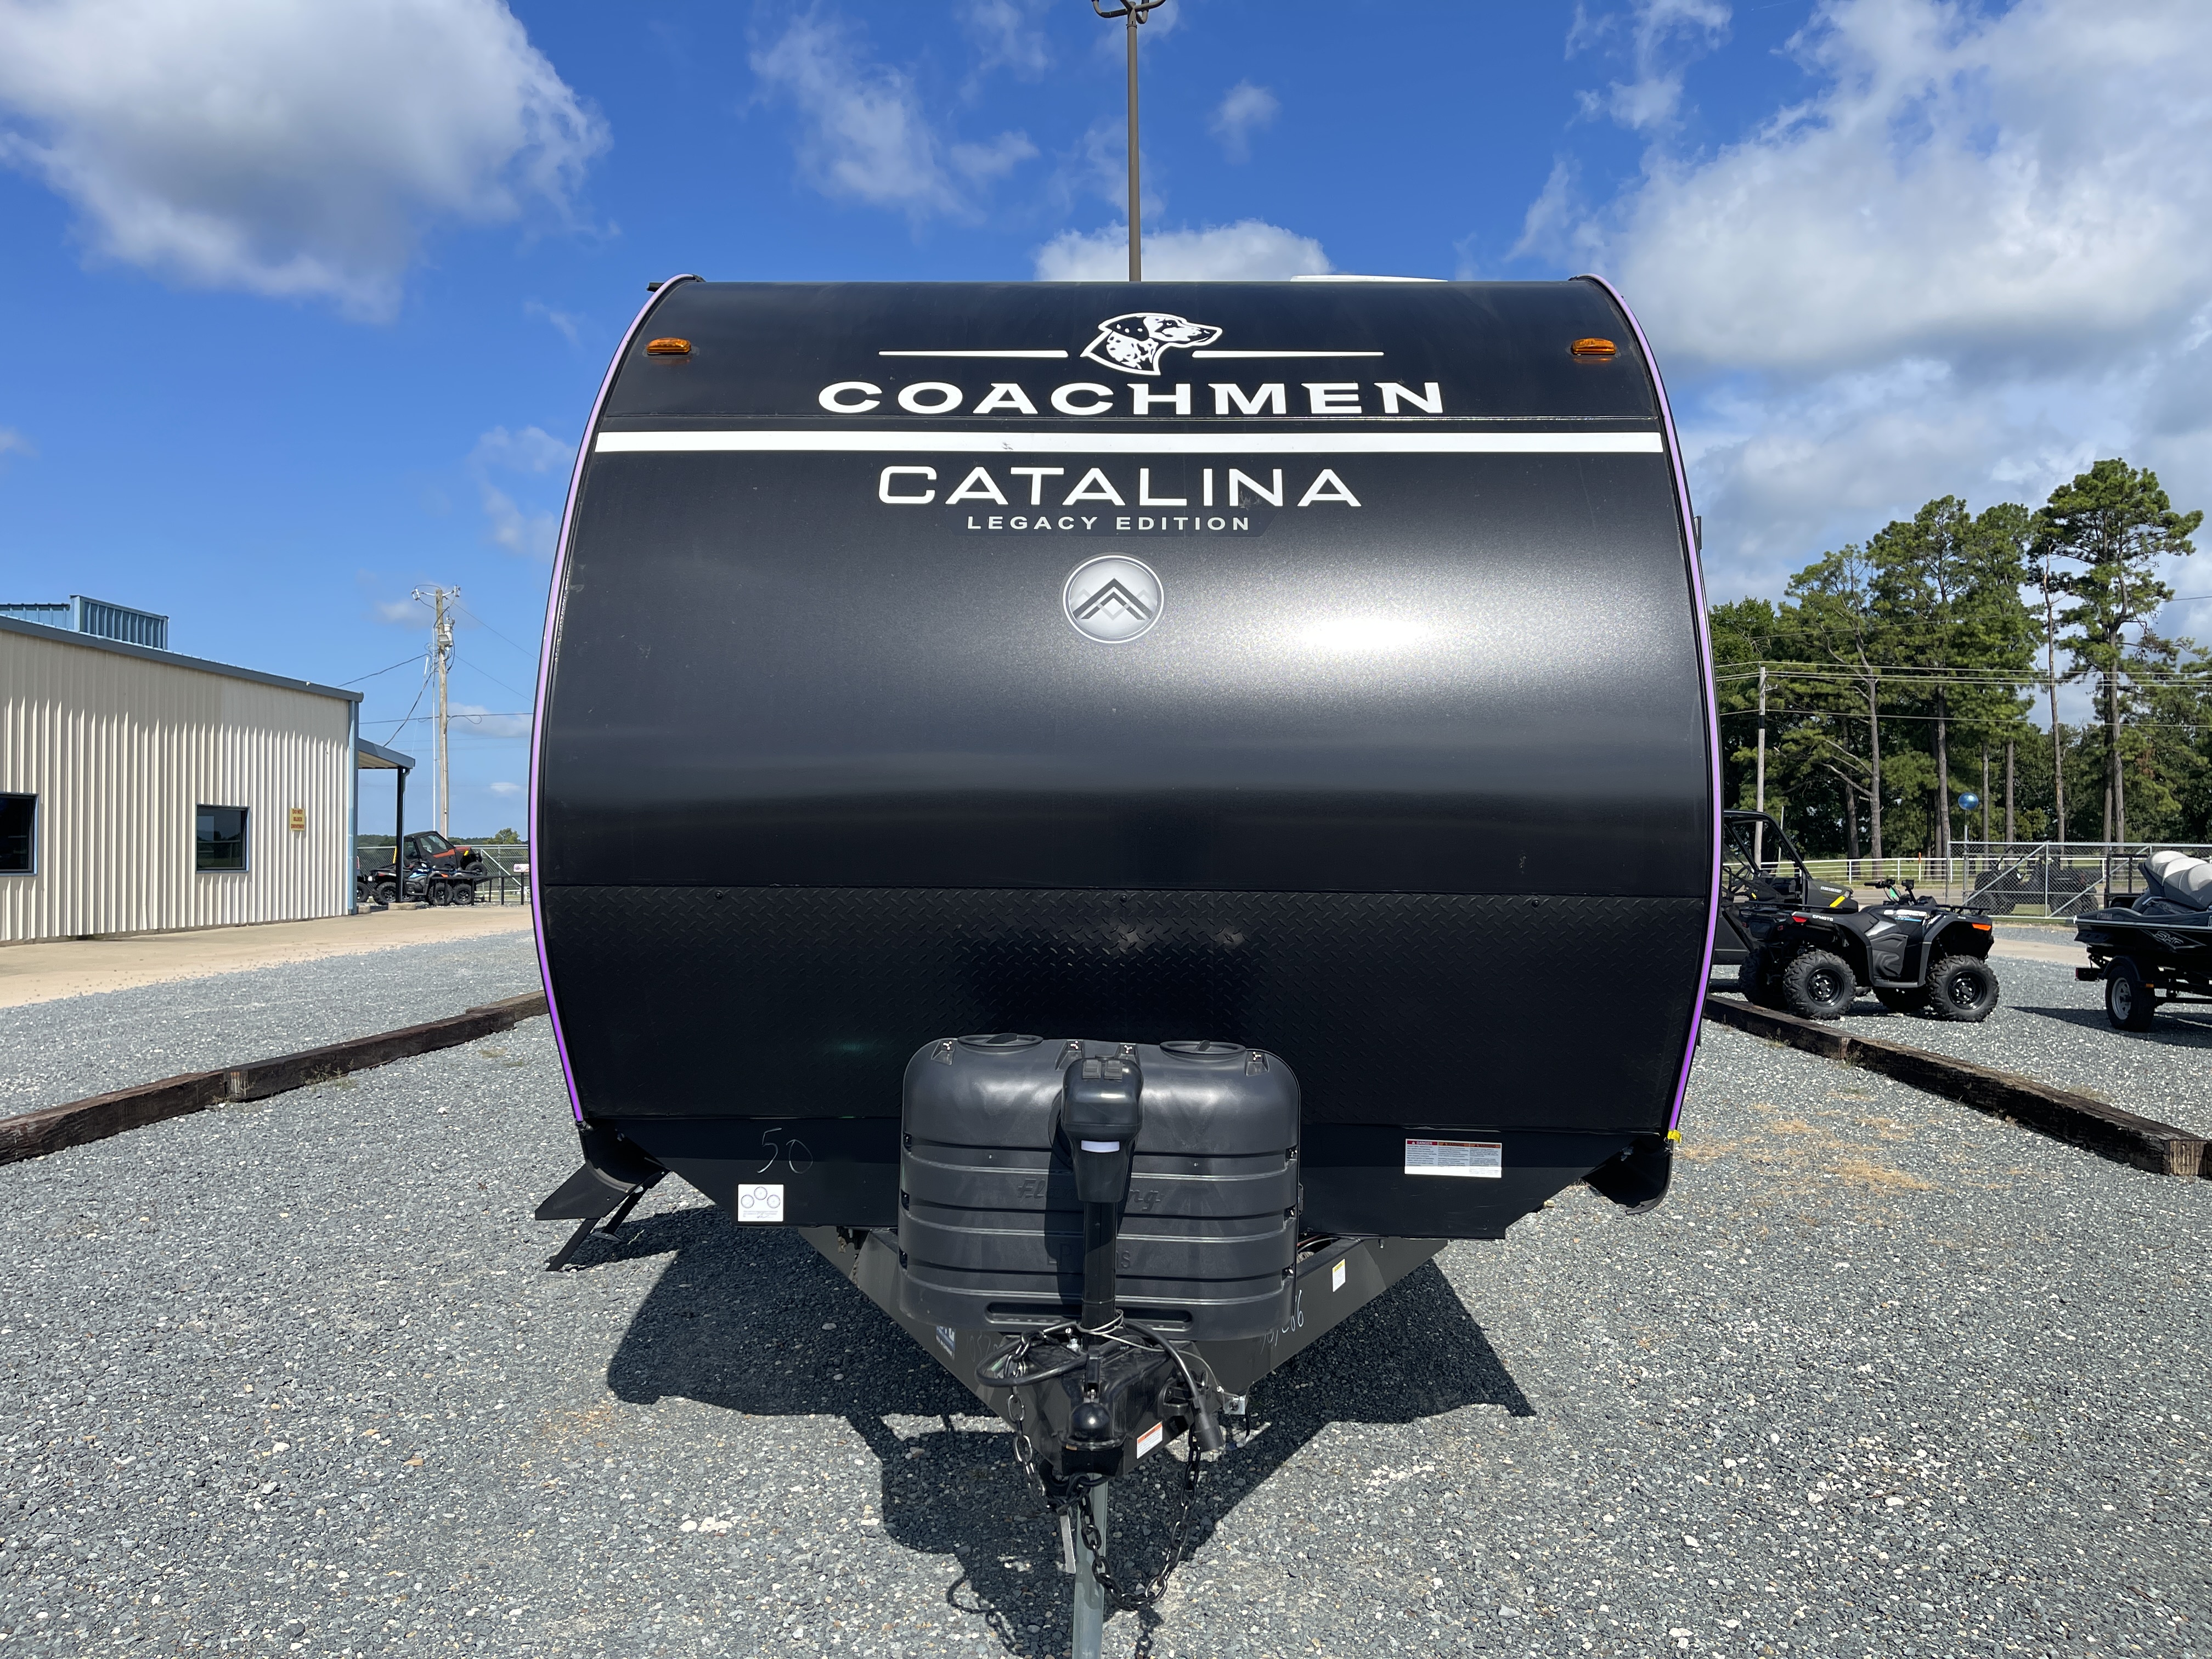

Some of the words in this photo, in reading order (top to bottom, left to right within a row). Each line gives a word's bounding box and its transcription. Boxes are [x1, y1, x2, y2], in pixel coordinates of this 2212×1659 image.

[819, 382, 1443, 415] COACHMEN
[879, 466, 1361, 507] CATALINA
[968, 516, 1098, 531] LEGACY
[1116, 517, 1248, 531] EDITION
[757, 1127, 814, 1174] 50
